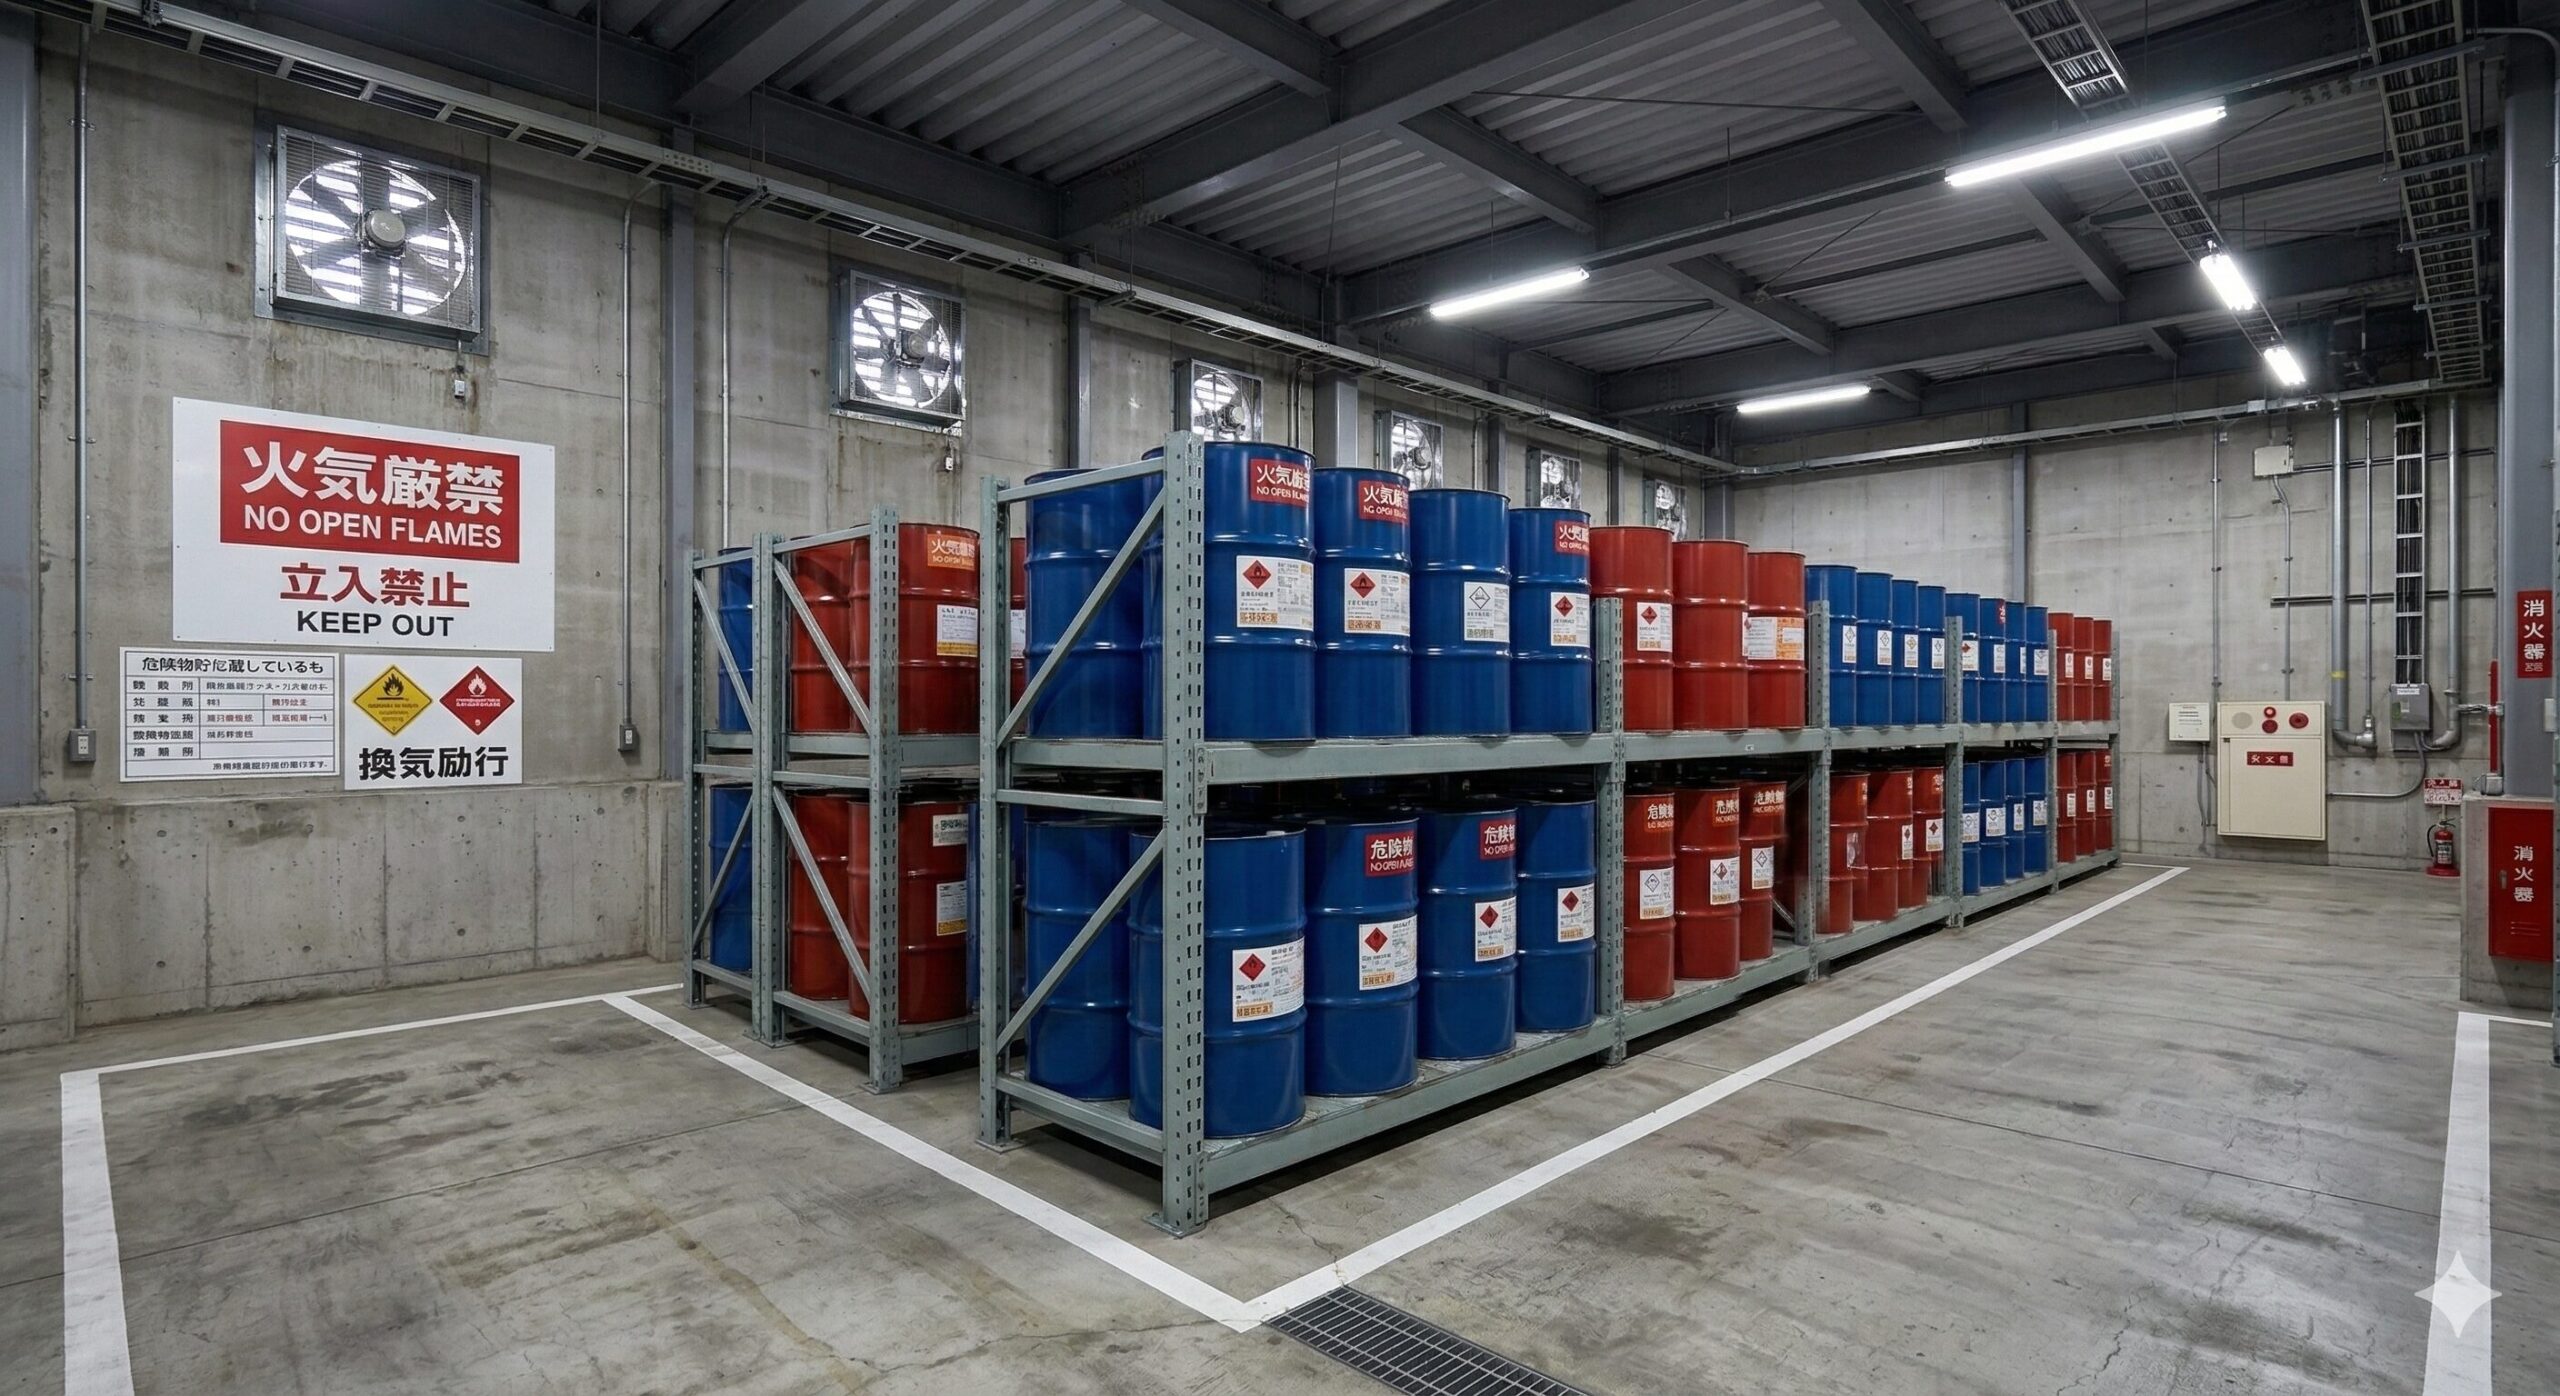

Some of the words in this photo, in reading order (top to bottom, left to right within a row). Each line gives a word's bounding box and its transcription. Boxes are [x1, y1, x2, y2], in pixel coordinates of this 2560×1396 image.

[241, 441, 504, 516] 火気厳禁
[244, 504, 290, 532] NO
[299, 509, 382, 540] OPEN
[391, 517, 502, 549] FLAMES
[280, 562, 470, 608] 立入禁止
[297, 610, 382, 634] KEEP
[391, 614, 454, 637] OUT
[2523, 599, 2545, 660] 消火器
[359, 746, 509, 781] 換気励行
[2513, 845, 2534, 902] 消火器
